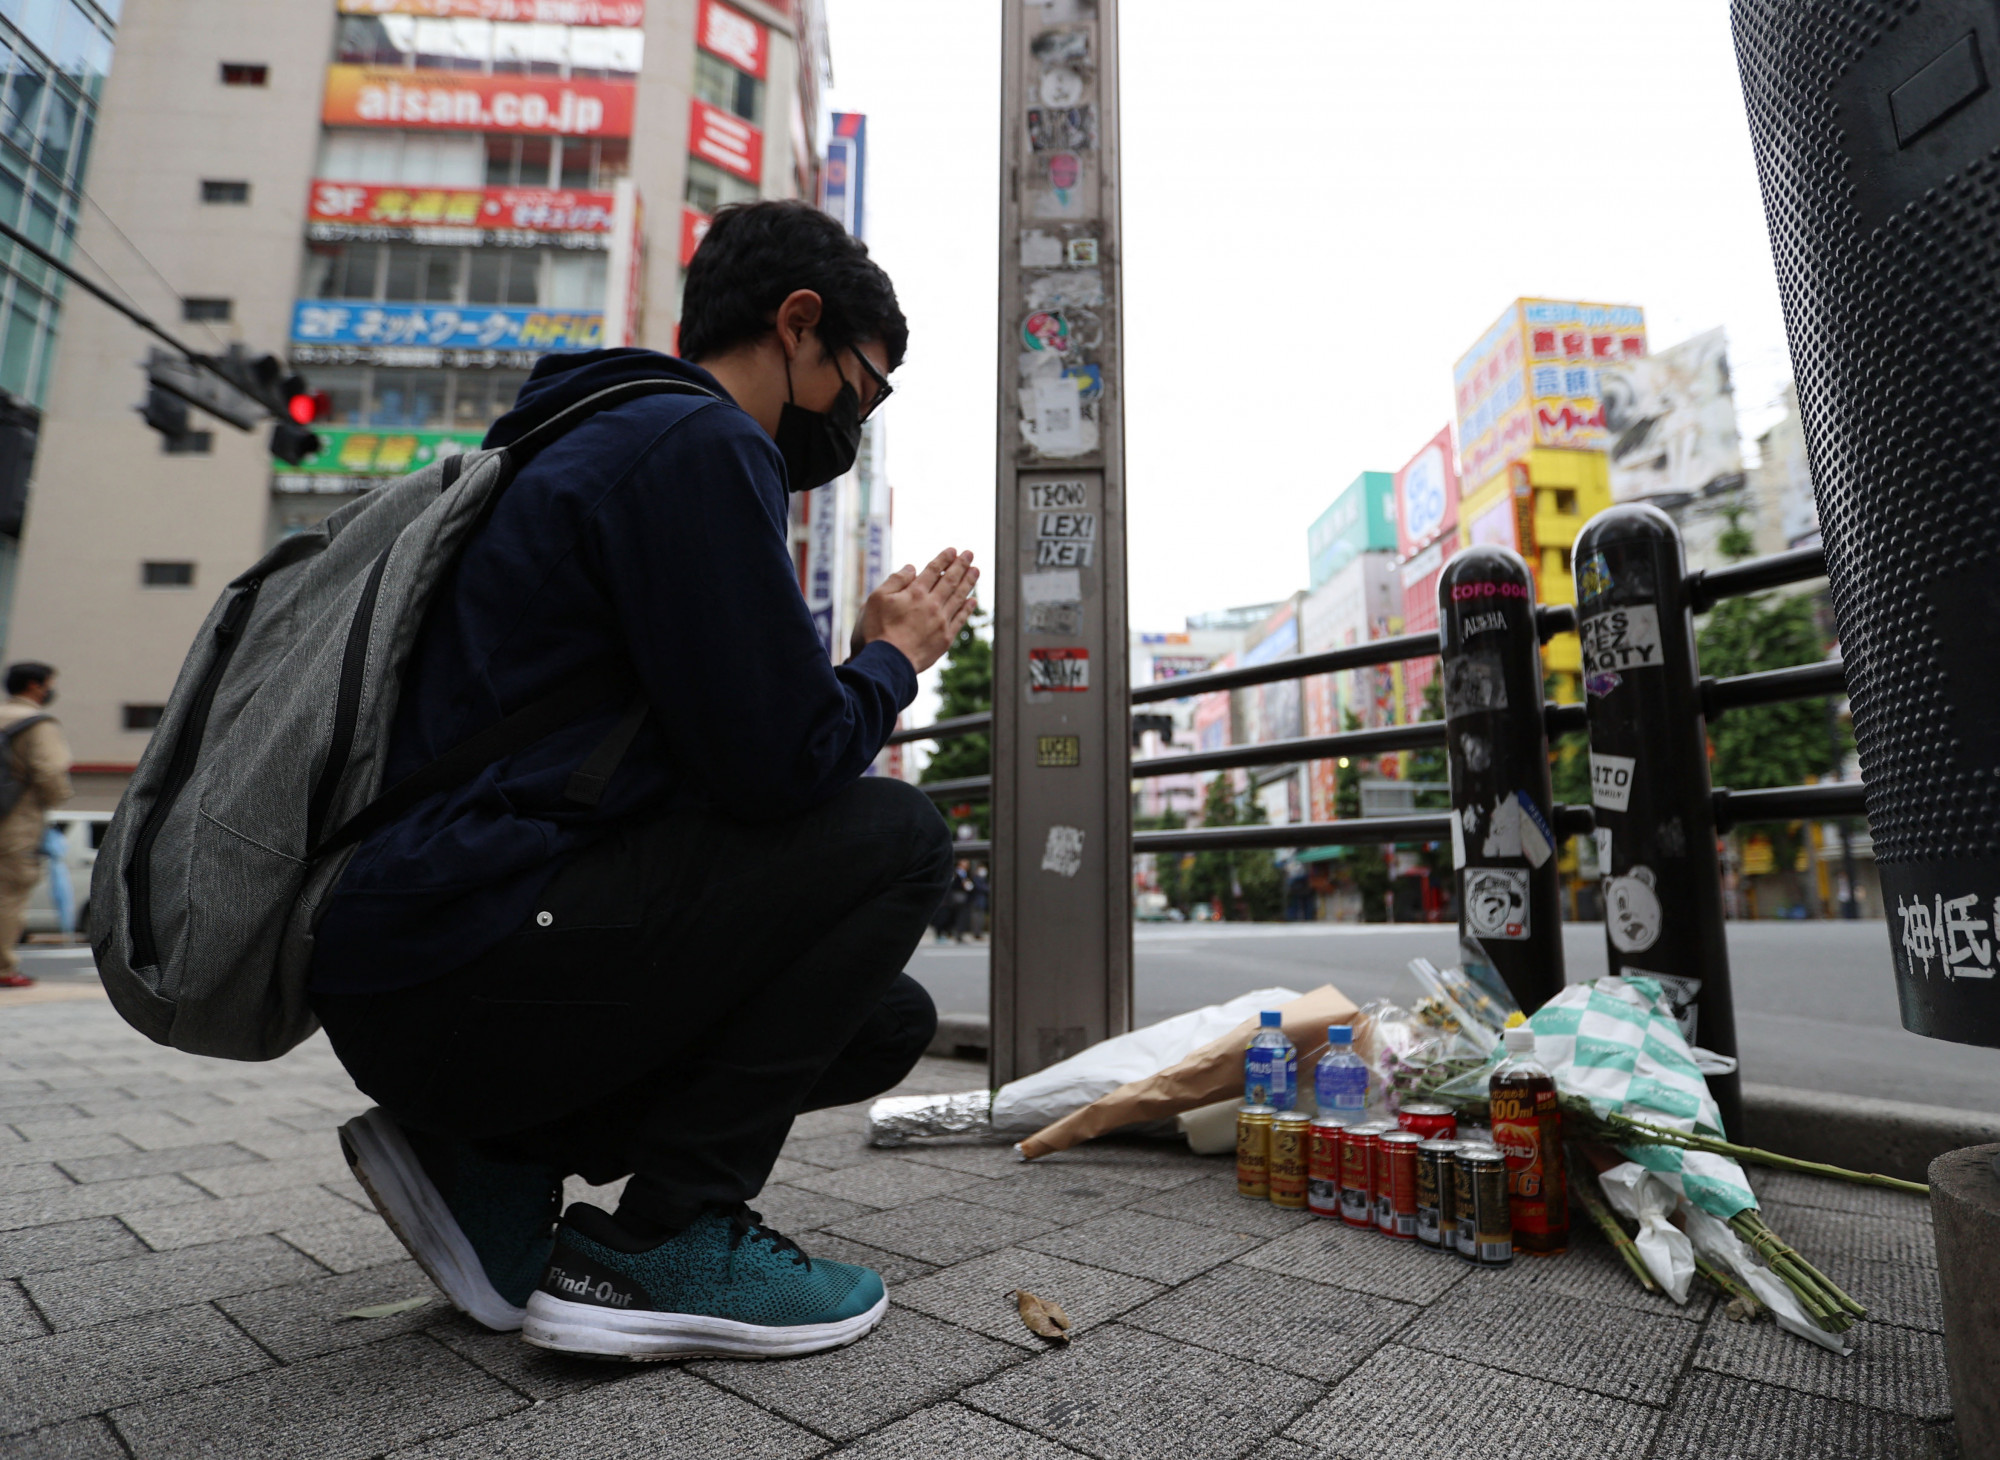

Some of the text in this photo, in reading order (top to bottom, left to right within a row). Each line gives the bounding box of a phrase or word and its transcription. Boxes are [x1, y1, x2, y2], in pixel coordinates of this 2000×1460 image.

[356, 84, 604, 133] aisan.co.jp
[314, 184, 367, 217] 3F
[298, 308, 350, 337] 2F
[1897, 893, 2000, 983] 神低
[546, 1266, 633, 1308] Find-Out
